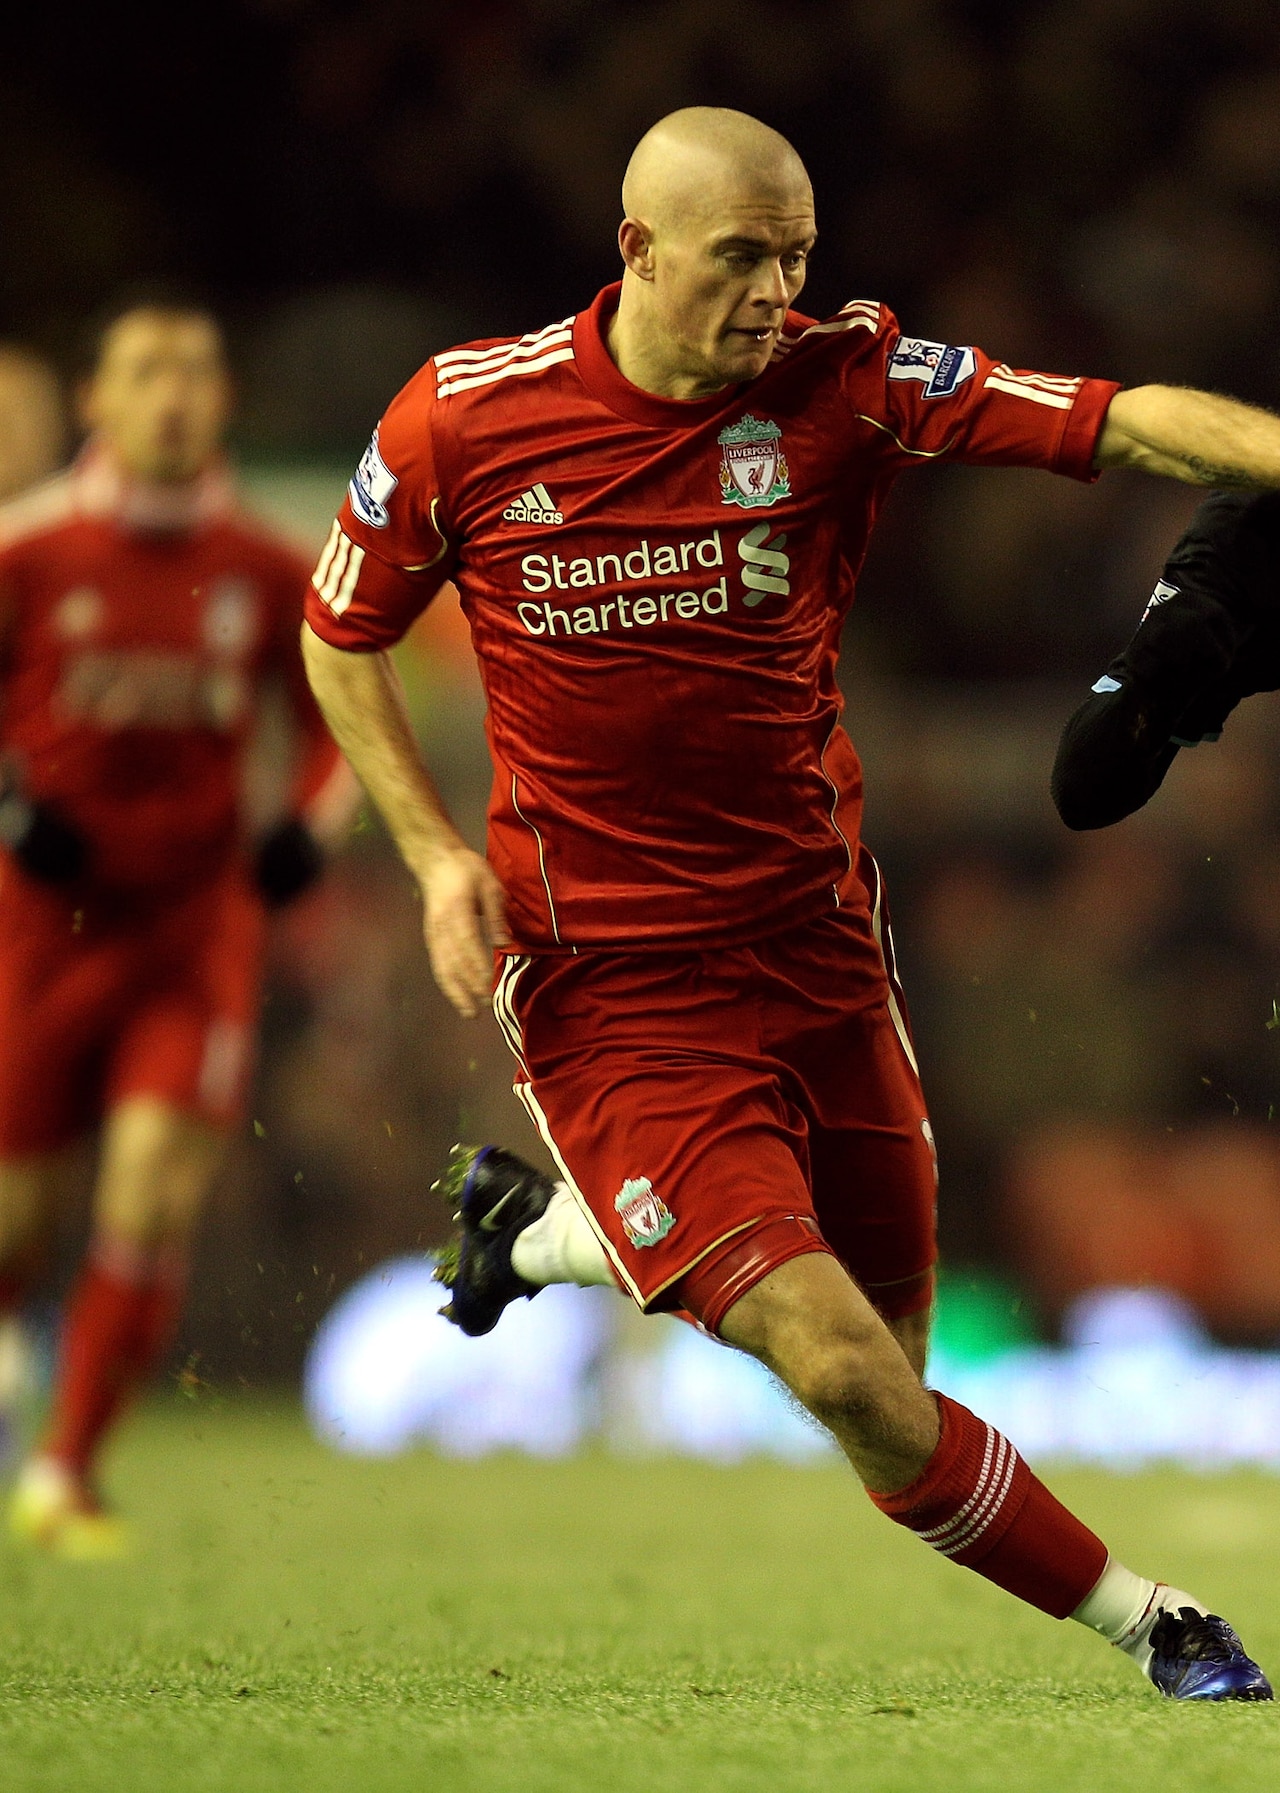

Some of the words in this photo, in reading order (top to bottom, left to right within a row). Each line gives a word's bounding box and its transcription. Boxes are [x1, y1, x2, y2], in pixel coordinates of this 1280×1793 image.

[729, 445, 774, 458] LIVERPOOL
[502, 507, 564, 525] adidas
[521, 529, 724, 593] Standard
[516, 577, 728, 636] Chartered
